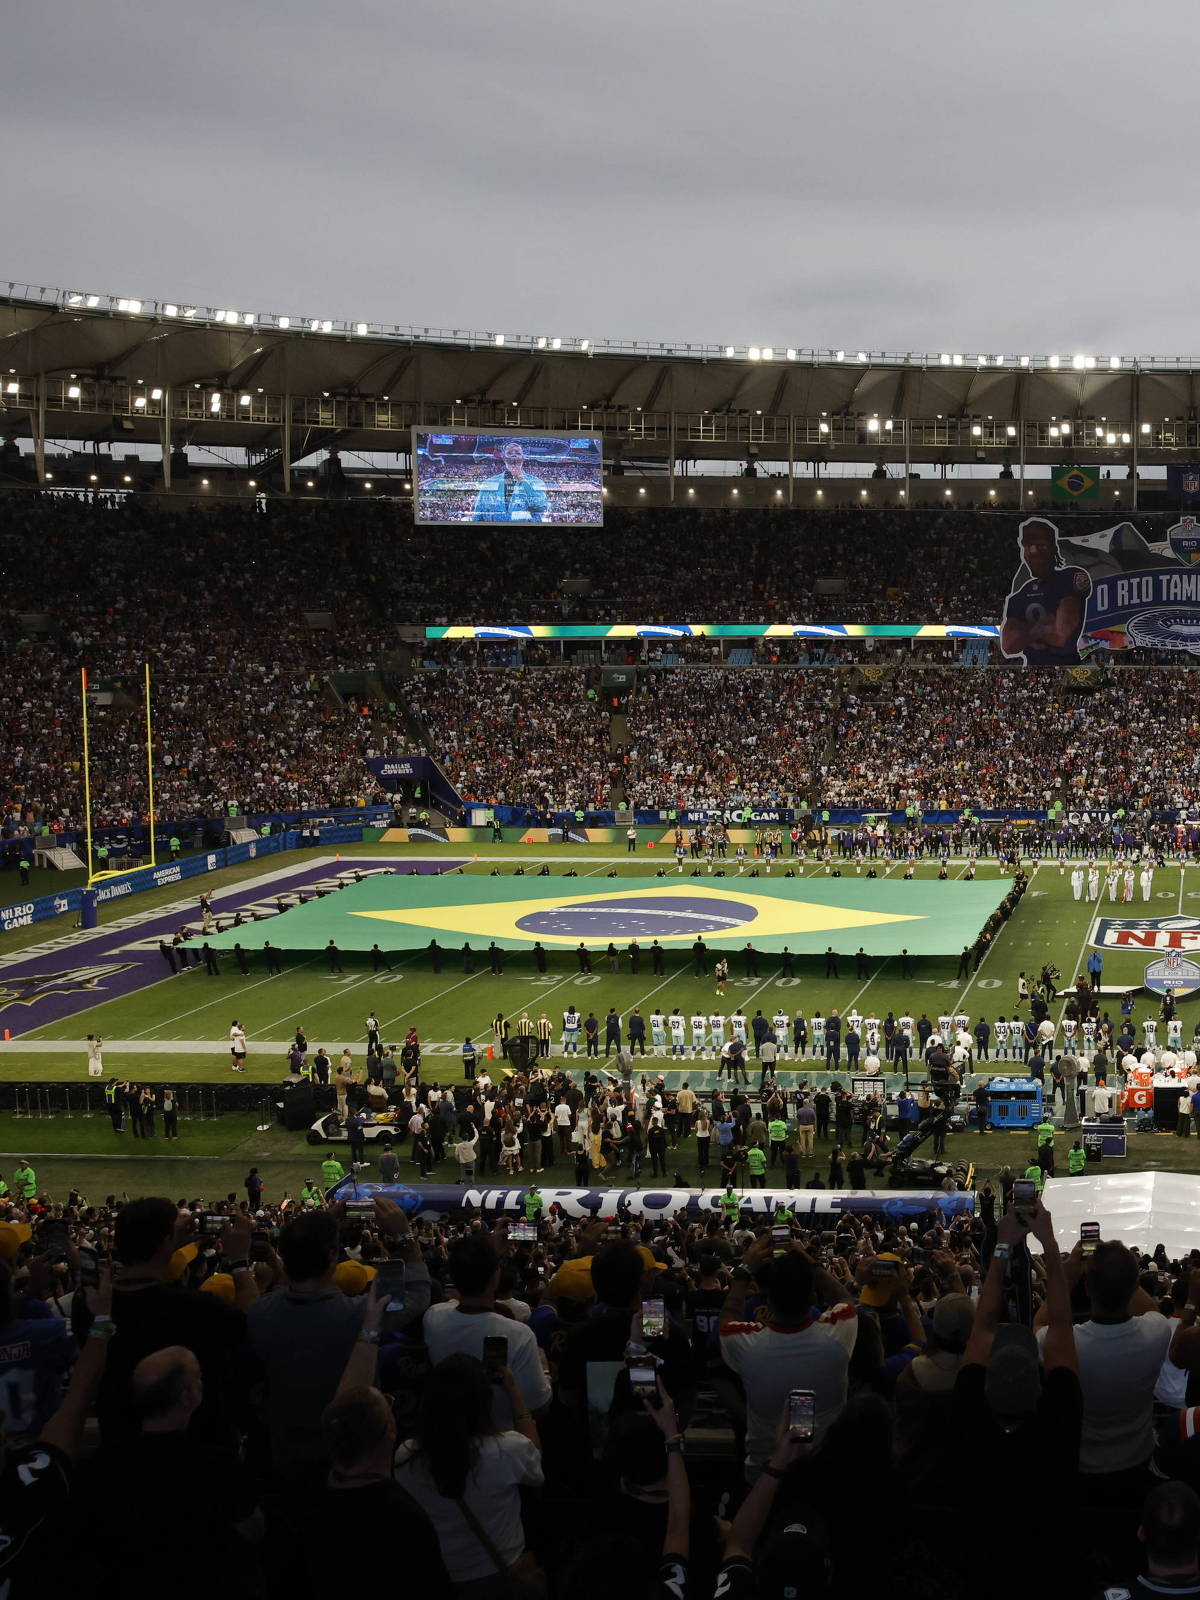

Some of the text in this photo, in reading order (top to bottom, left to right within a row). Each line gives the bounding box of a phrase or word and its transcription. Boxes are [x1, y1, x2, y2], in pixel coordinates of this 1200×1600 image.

[1096, 583, 1109, 611] O
[1117, 576, 1153, 607] RIO
[153, 865, 181, 880] AMERICAN
[157, 873, 182, 886] EXPRESS
[97, 889, 111, 903] JACK
[4, 914, 34, 931] GAME
[1167, 957, 1181, 968] NFL
[936, 978, 1004, 990] 40
[997, 1025, 1006, 1035] 33
[1012, 1026, 1021, 1035] 13
[1133, 1091, 1147, 1105] G
[460, 1189, 522, 1210] NFL
